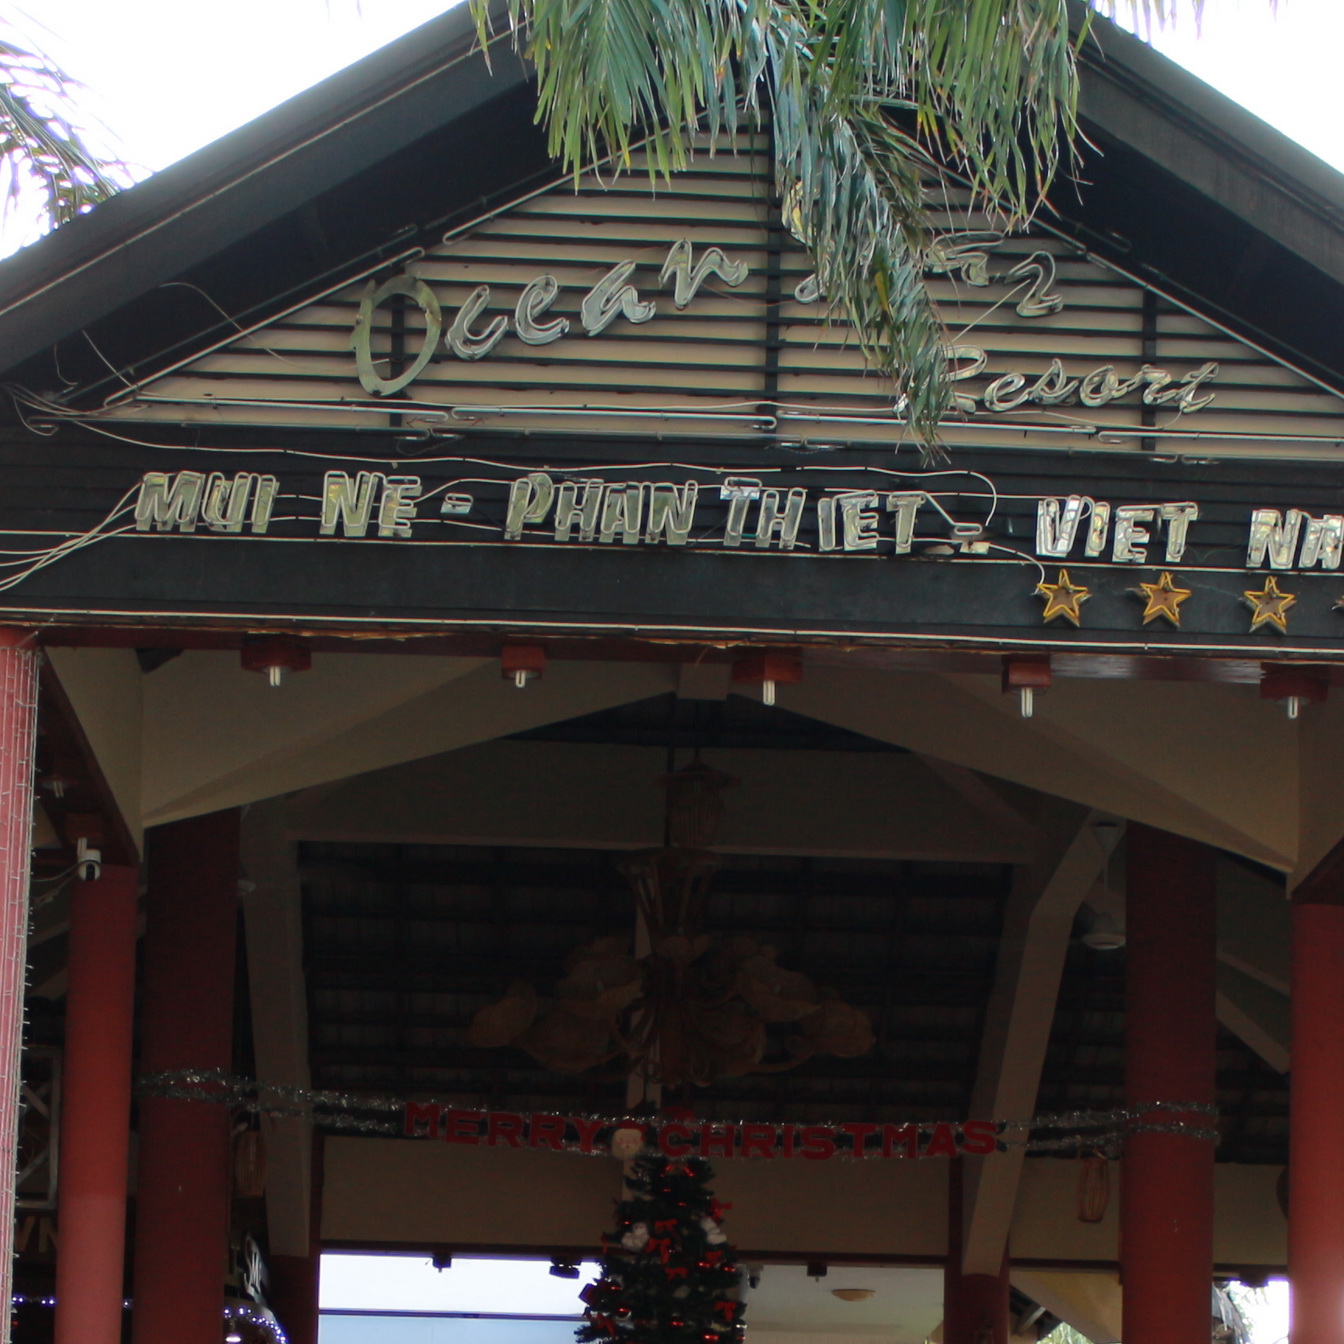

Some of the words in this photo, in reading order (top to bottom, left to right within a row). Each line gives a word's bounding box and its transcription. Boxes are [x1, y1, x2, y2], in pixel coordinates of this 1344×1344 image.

[350, 238, 749, 397] Ocean
[135, 471, 280, 533] MUI
[319, 470, 422, 537] NE
[504, 473, 698, 545] PHAN
[720, 477, 926, 554] THIET
[1036, 495, 1198, 563] VIET
[406, 1101, 606, 1153] MERRY
[658, 1120, 998, 1160] CHRISTMAS
